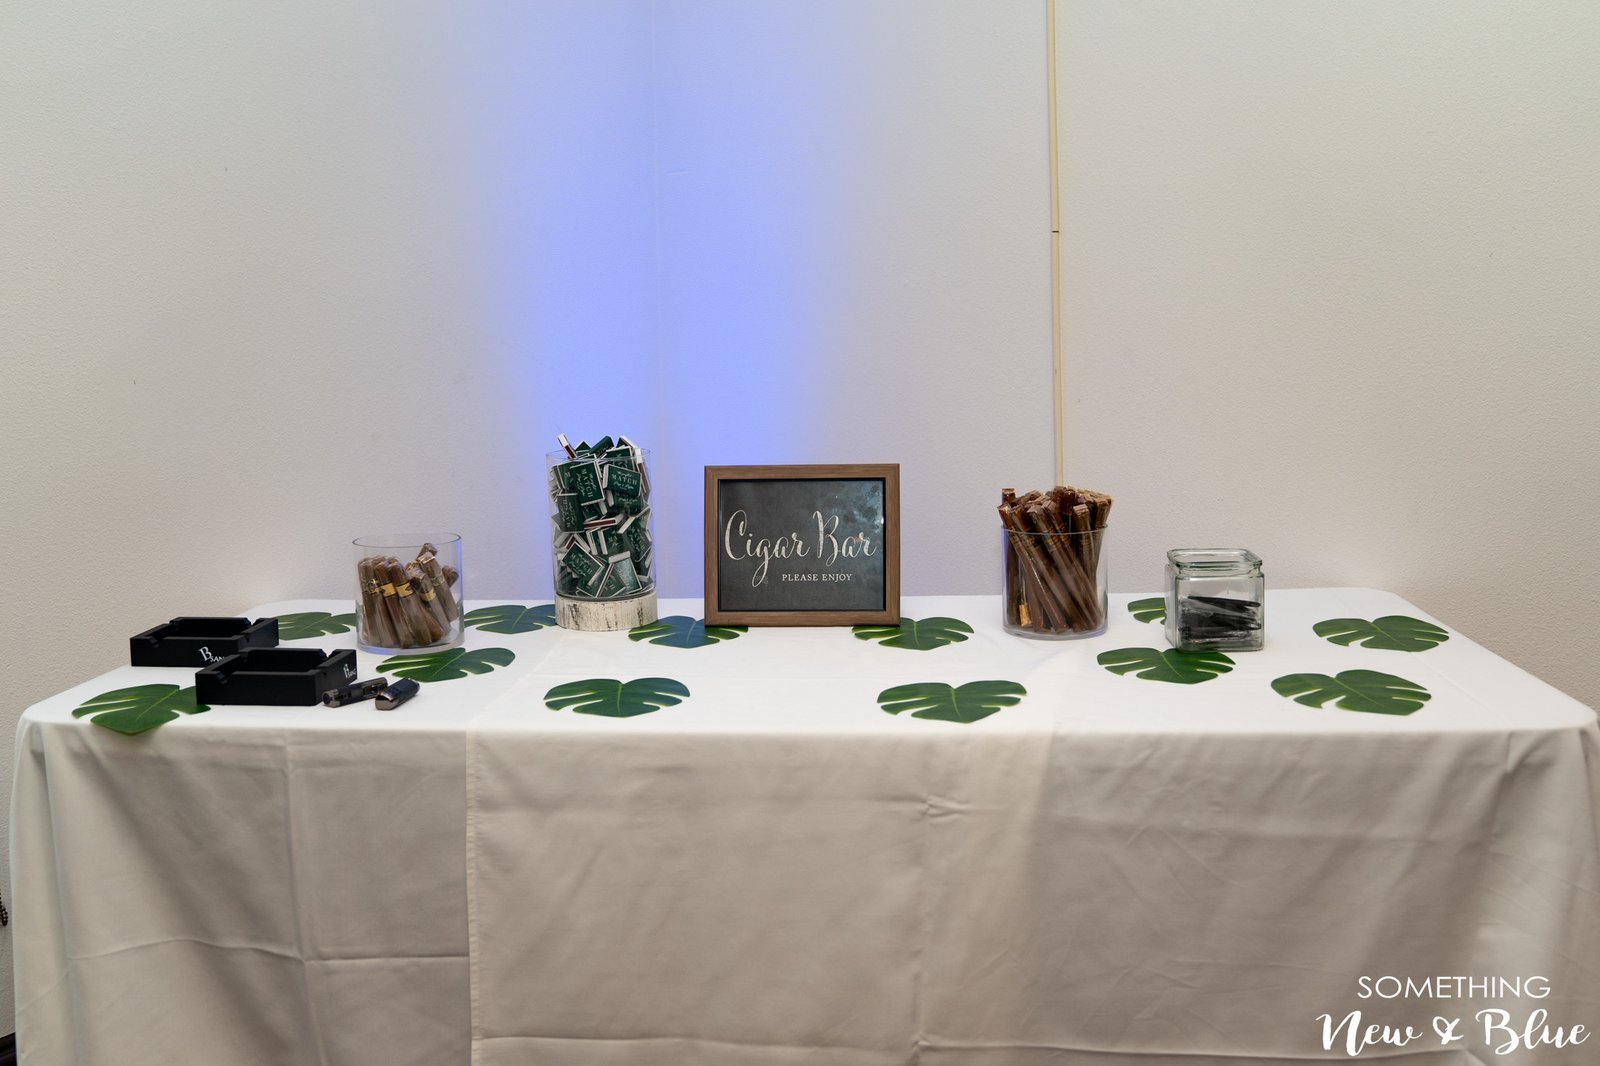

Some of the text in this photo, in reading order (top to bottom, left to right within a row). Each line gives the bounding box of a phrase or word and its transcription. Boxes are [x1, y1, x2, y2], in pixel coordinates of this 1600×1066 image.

[611, 473, 639, 486] MATCH
[724, 509, 877, 588] Cigar Bar
[782, 573, 853, 583] PLEASE ENJOY
